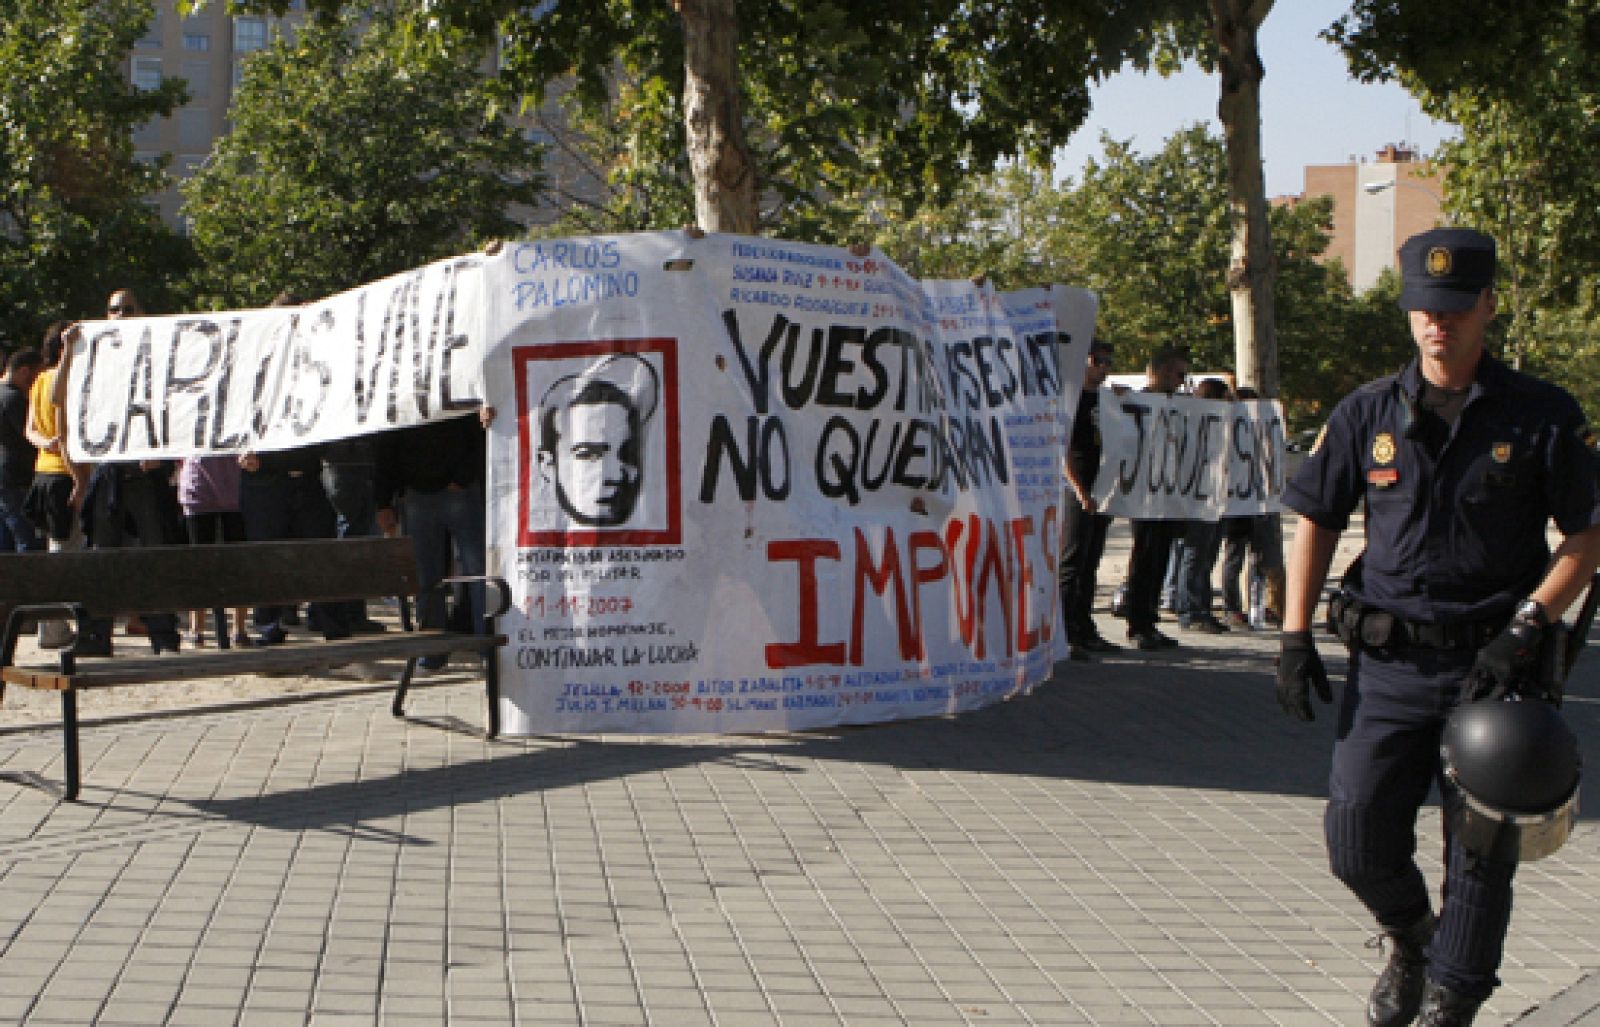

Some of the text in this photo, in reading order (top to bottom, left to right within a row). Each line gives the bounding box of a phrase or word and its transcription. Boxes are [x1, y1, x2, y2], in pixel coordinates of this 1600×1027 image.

[515, 241, 620, 273] CARLOS
[512, 271, 639, 311] PALOMINO
[79, 309, 334, 456] CARLOS
[701, 413, 790, 504] NO
[765, 506, 1057, 669] IMPUNES
[517, 628, 536, 643] EL
[517, 645, 617, 670] CONTINUAR
[622, 646, 647, 665] LA
